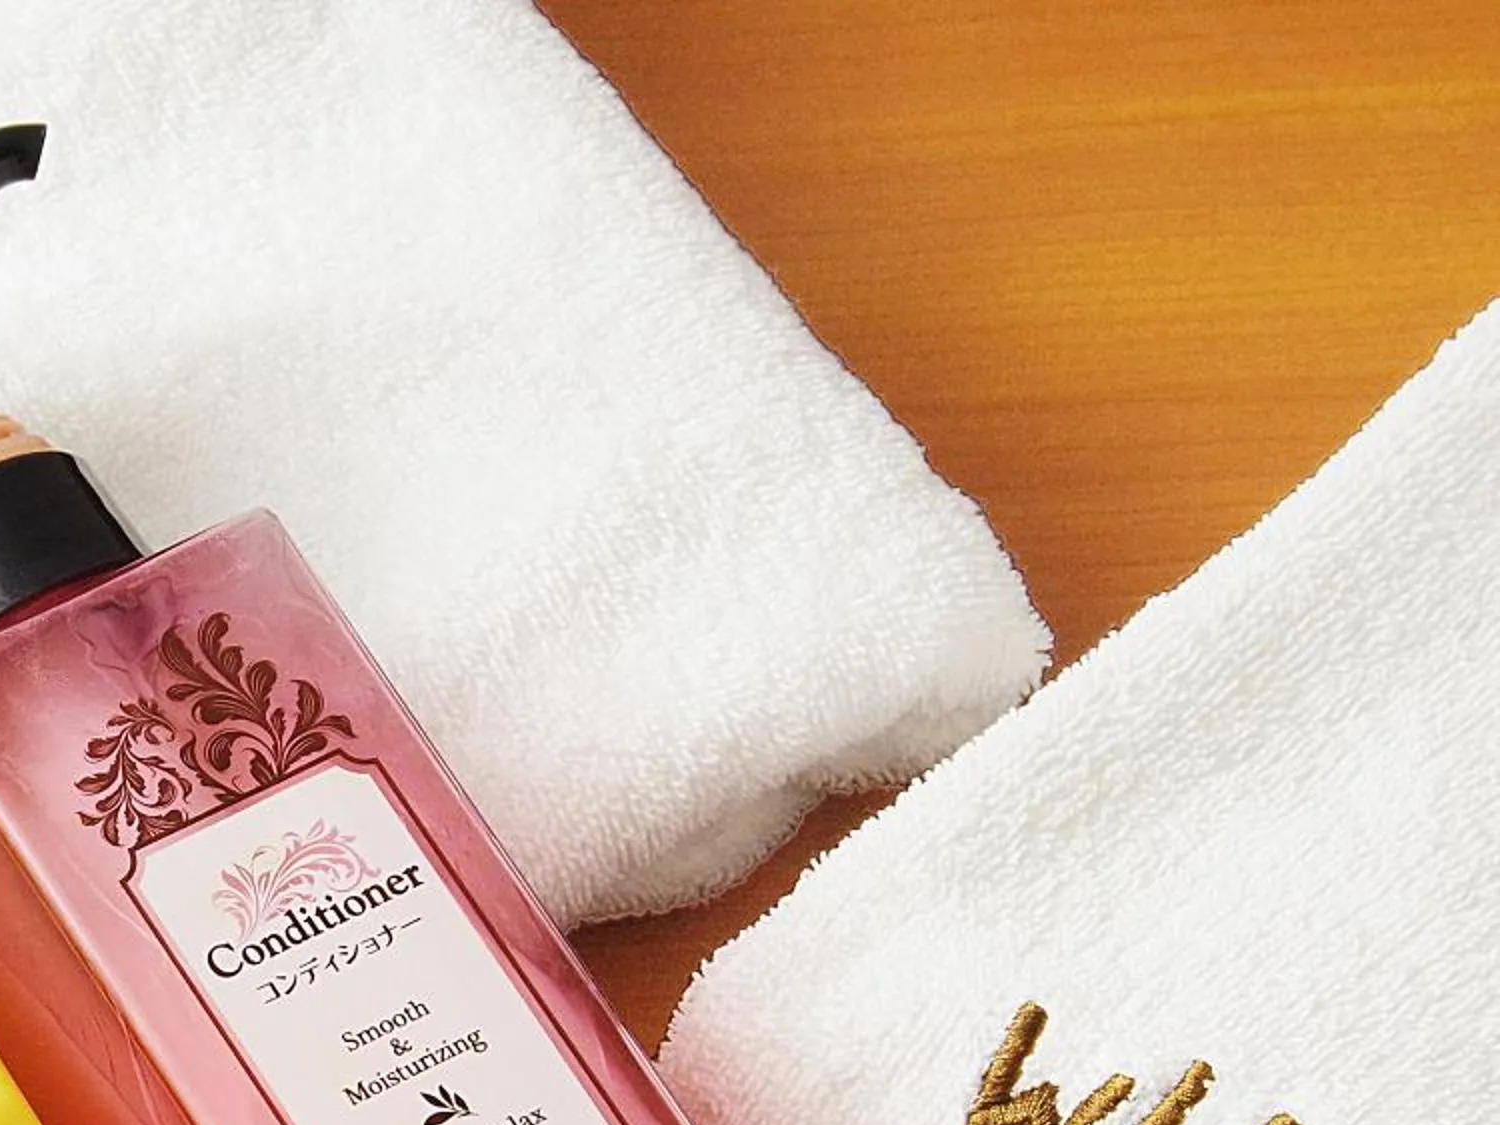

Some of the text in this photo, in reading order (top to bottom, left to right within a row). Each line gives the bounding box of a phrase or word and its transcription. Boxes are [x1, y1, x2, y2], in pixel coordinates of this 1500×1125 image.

[207, 862, 424, 979] Conditioner
[256, 917, 422, 1005] コンディショナー
[341, 1000, 431, 1053] Smooth
[390, 1036, 412, 1056] &
[342, 1028, 488, 1106] Moisturizing
